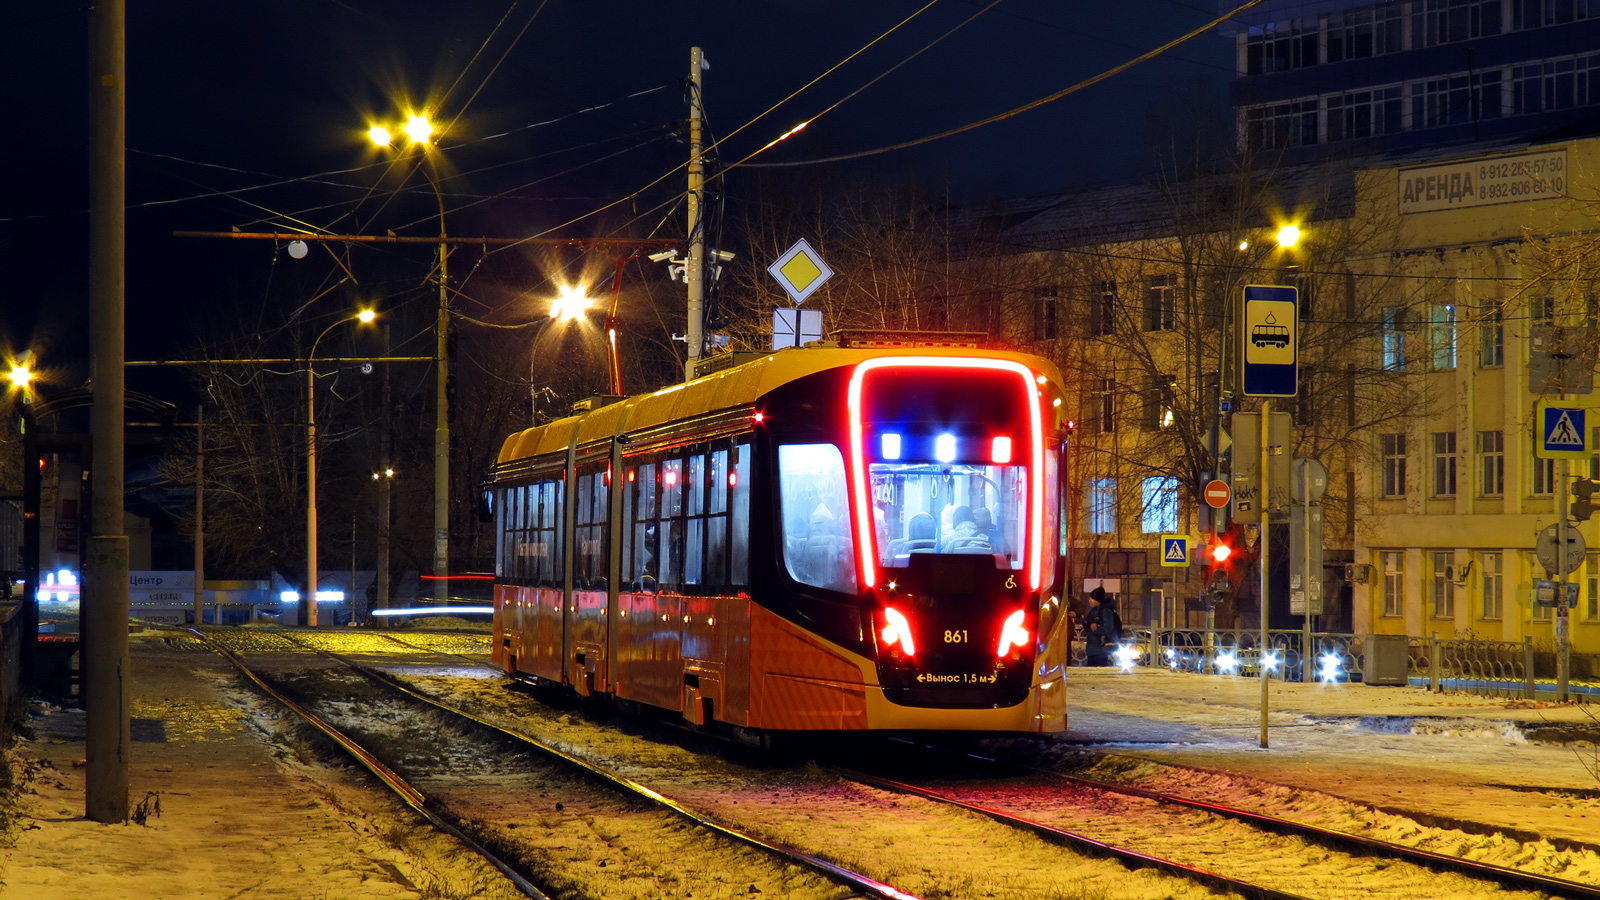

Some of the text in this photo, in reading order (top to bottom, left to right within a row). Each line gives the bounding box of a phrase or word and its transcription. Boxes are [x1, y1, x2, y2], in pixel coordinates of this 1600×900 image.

[1403, 172, 1474, 203] АРЕНДА
[129, 575, 163, 586] Центр
[943, 629, 969, 644] 861
[926, 673, 960, 683] Вынос
[963, 673, 977, 684] 1,5
